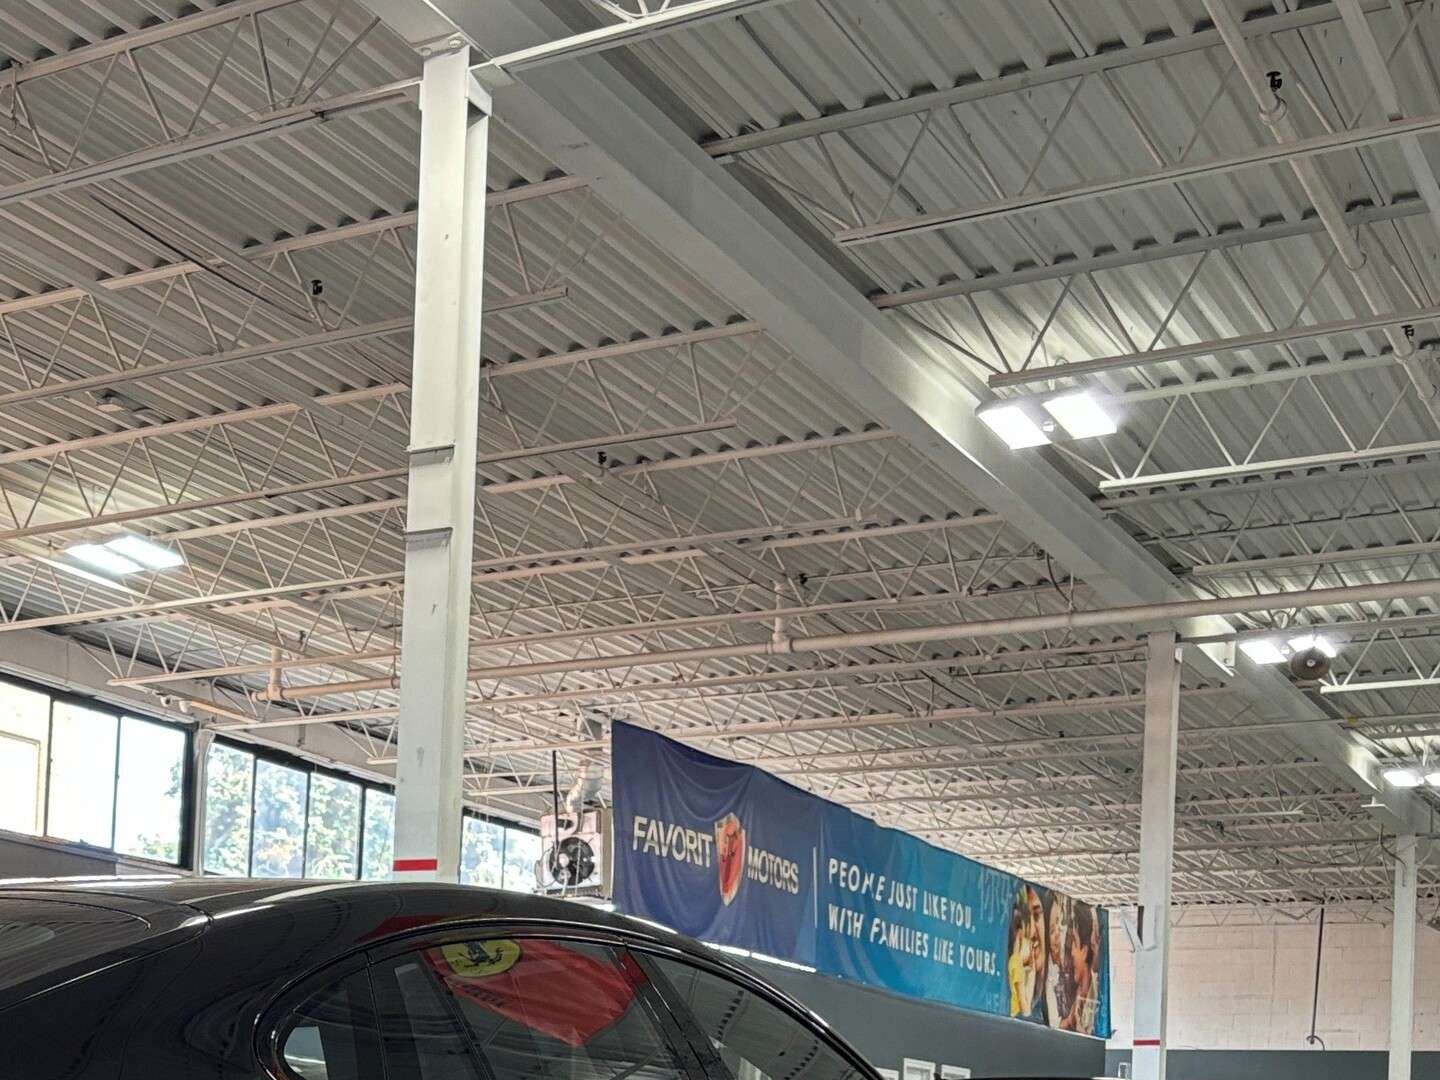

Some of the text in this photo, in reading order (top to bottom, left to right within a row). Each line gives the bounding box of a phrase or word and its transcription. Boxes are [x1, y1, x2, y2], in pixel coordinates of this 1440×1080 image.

[632, 815, 799, 895] FAVORIT MOTORS
[828, 903, 1000, 977] WITH FAMILIES LIKE YOURS.
[888, 880, 918, 912] JUST
[923, 890, 947, 921] LIKE
[949, 900, 976, 933] YOU,
